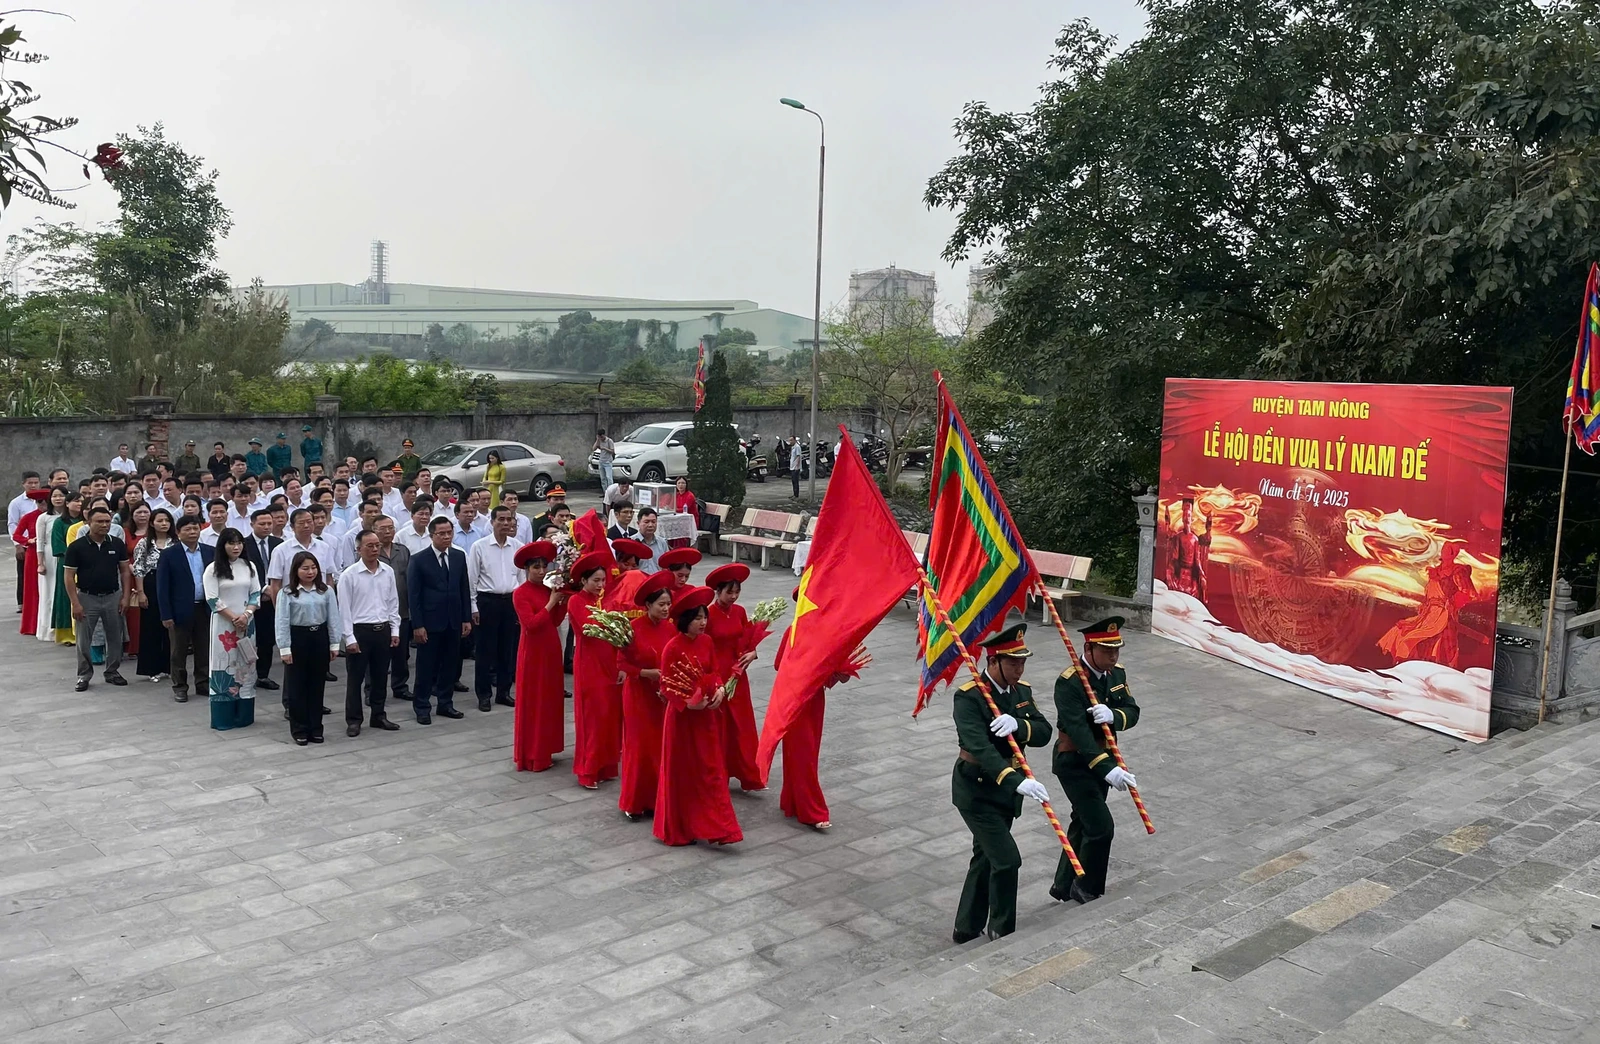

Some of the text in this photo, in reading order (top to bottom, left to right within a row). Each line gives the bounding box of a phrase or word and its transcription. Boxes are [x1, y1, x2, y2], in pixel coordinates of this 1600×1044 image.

[1252, 395, 1370, 420] HUYỆN TAM NÔNG
[1203, 421, 1432, 481] LỄ HỘI ĐỀN VUA LÝ NAM ĐẾ
[1258, 477, 1284, 499] Năm
[1322, 488, 1350, 508] 2025
